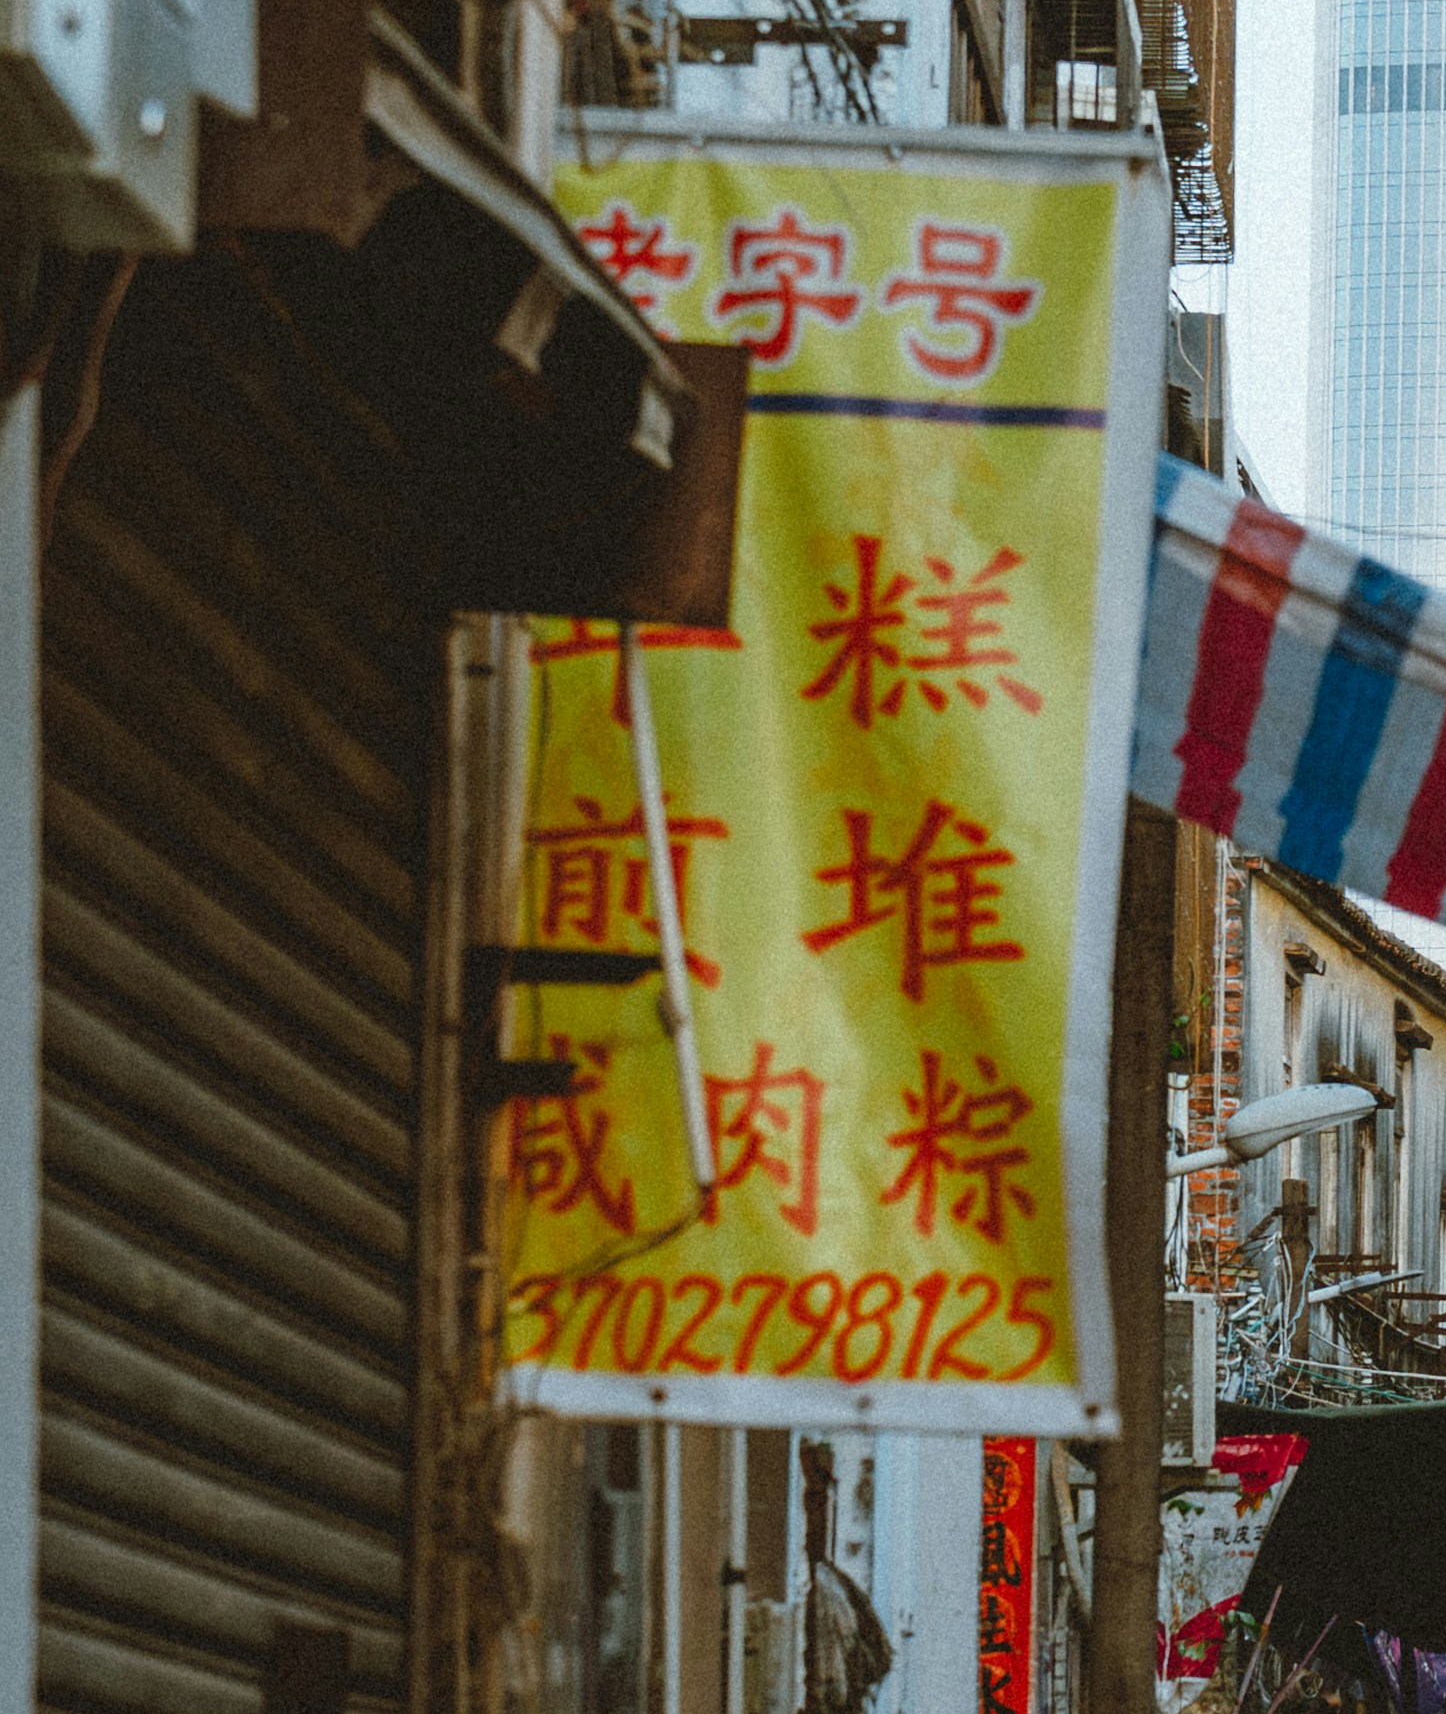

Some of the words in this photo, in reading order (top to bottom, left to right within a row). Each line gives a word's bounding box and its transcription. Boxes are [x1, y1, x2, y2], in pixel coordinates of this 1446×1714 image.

[526, 794, 1028, 1005] 煎堆
[507, 1031, 1038, 1246] 咸肉粽
[507, 1269, 1058, 1385] 3702798125
